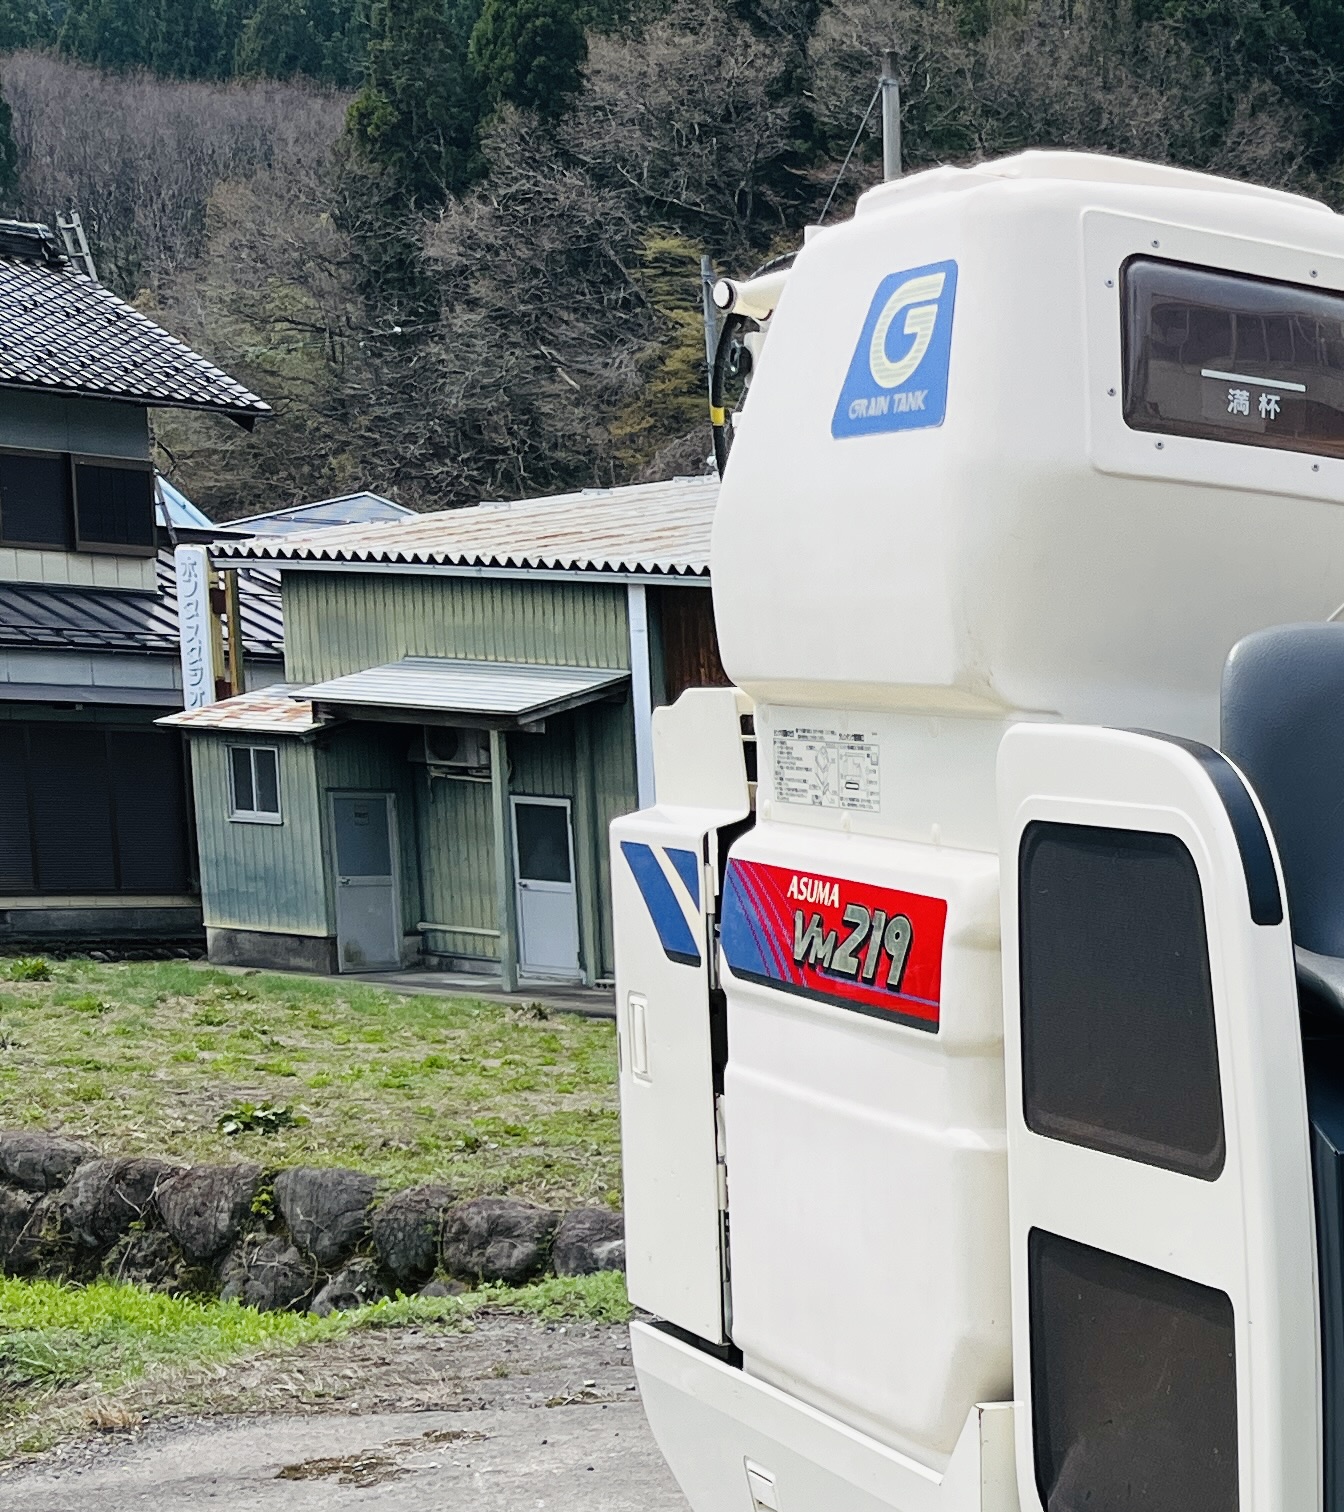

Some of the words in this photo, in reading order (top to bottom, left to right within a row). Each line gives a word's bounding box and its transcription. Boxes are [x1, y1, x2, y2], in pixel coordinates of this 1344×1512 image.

[870, 272, 946, 389] G
[848, 394, 889, 419] GRAIN
[893, 390, 929, 414] TANK
[1227, 389, 1281, 420] 満杯
[786, 875, 840, 909] ASUMA
